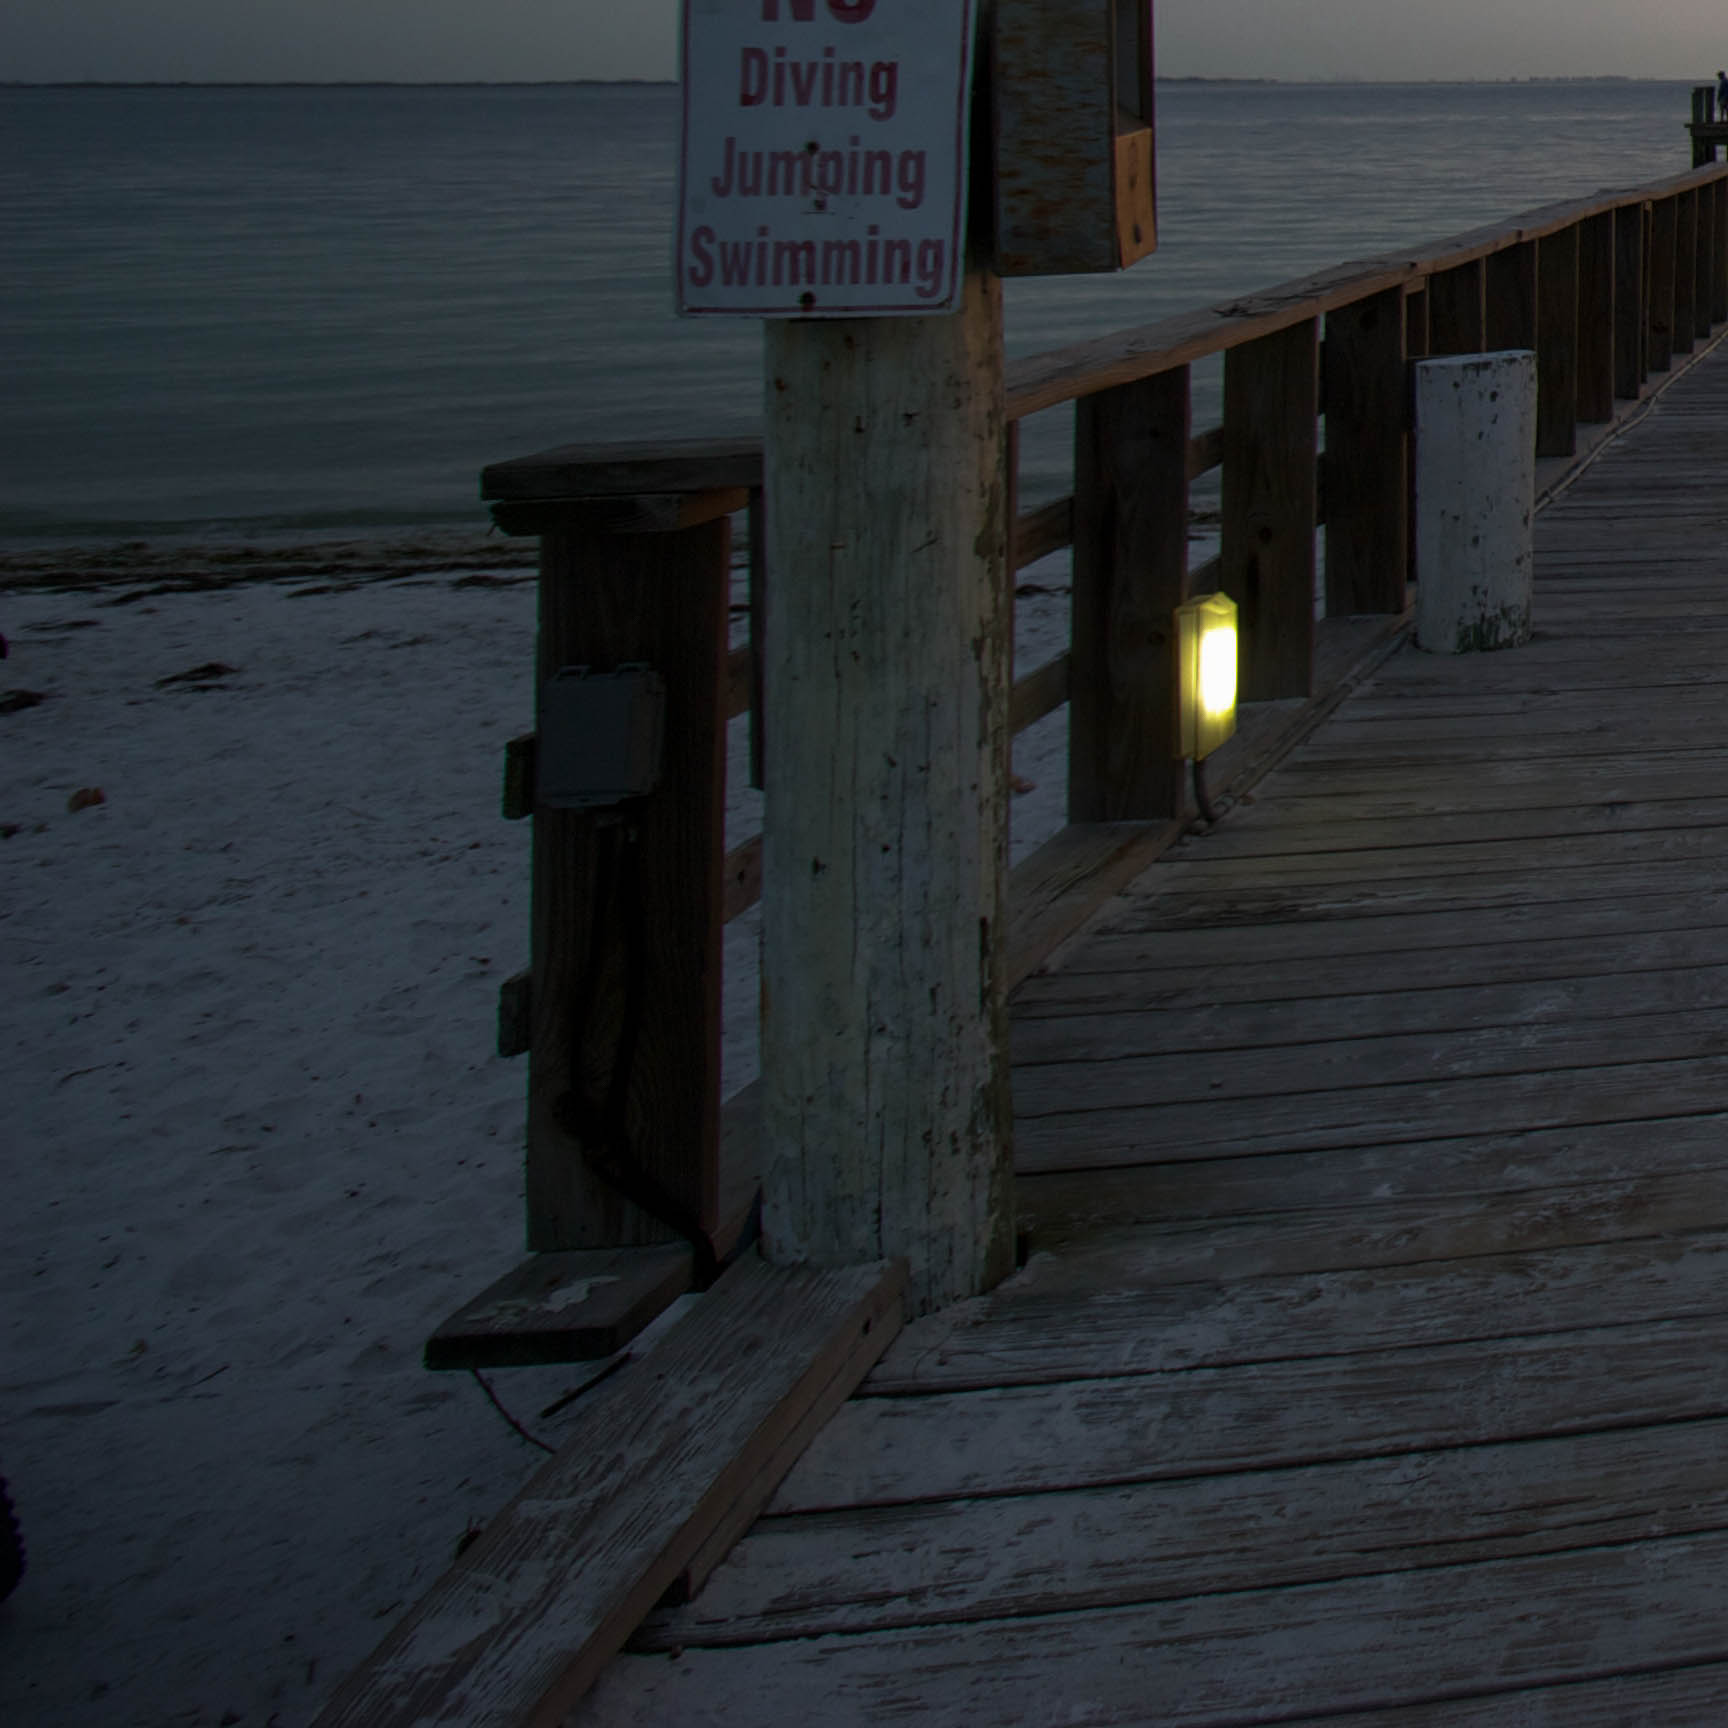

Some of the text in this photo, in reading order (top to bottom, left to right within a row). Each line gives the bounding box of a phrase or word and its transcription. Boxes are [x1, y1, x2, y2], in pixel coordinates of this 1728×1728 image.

[739, 45, 899, 122] Diving
[711, 135, 927, 210] Jumping
[688, 224, 946, 299] Swimming
